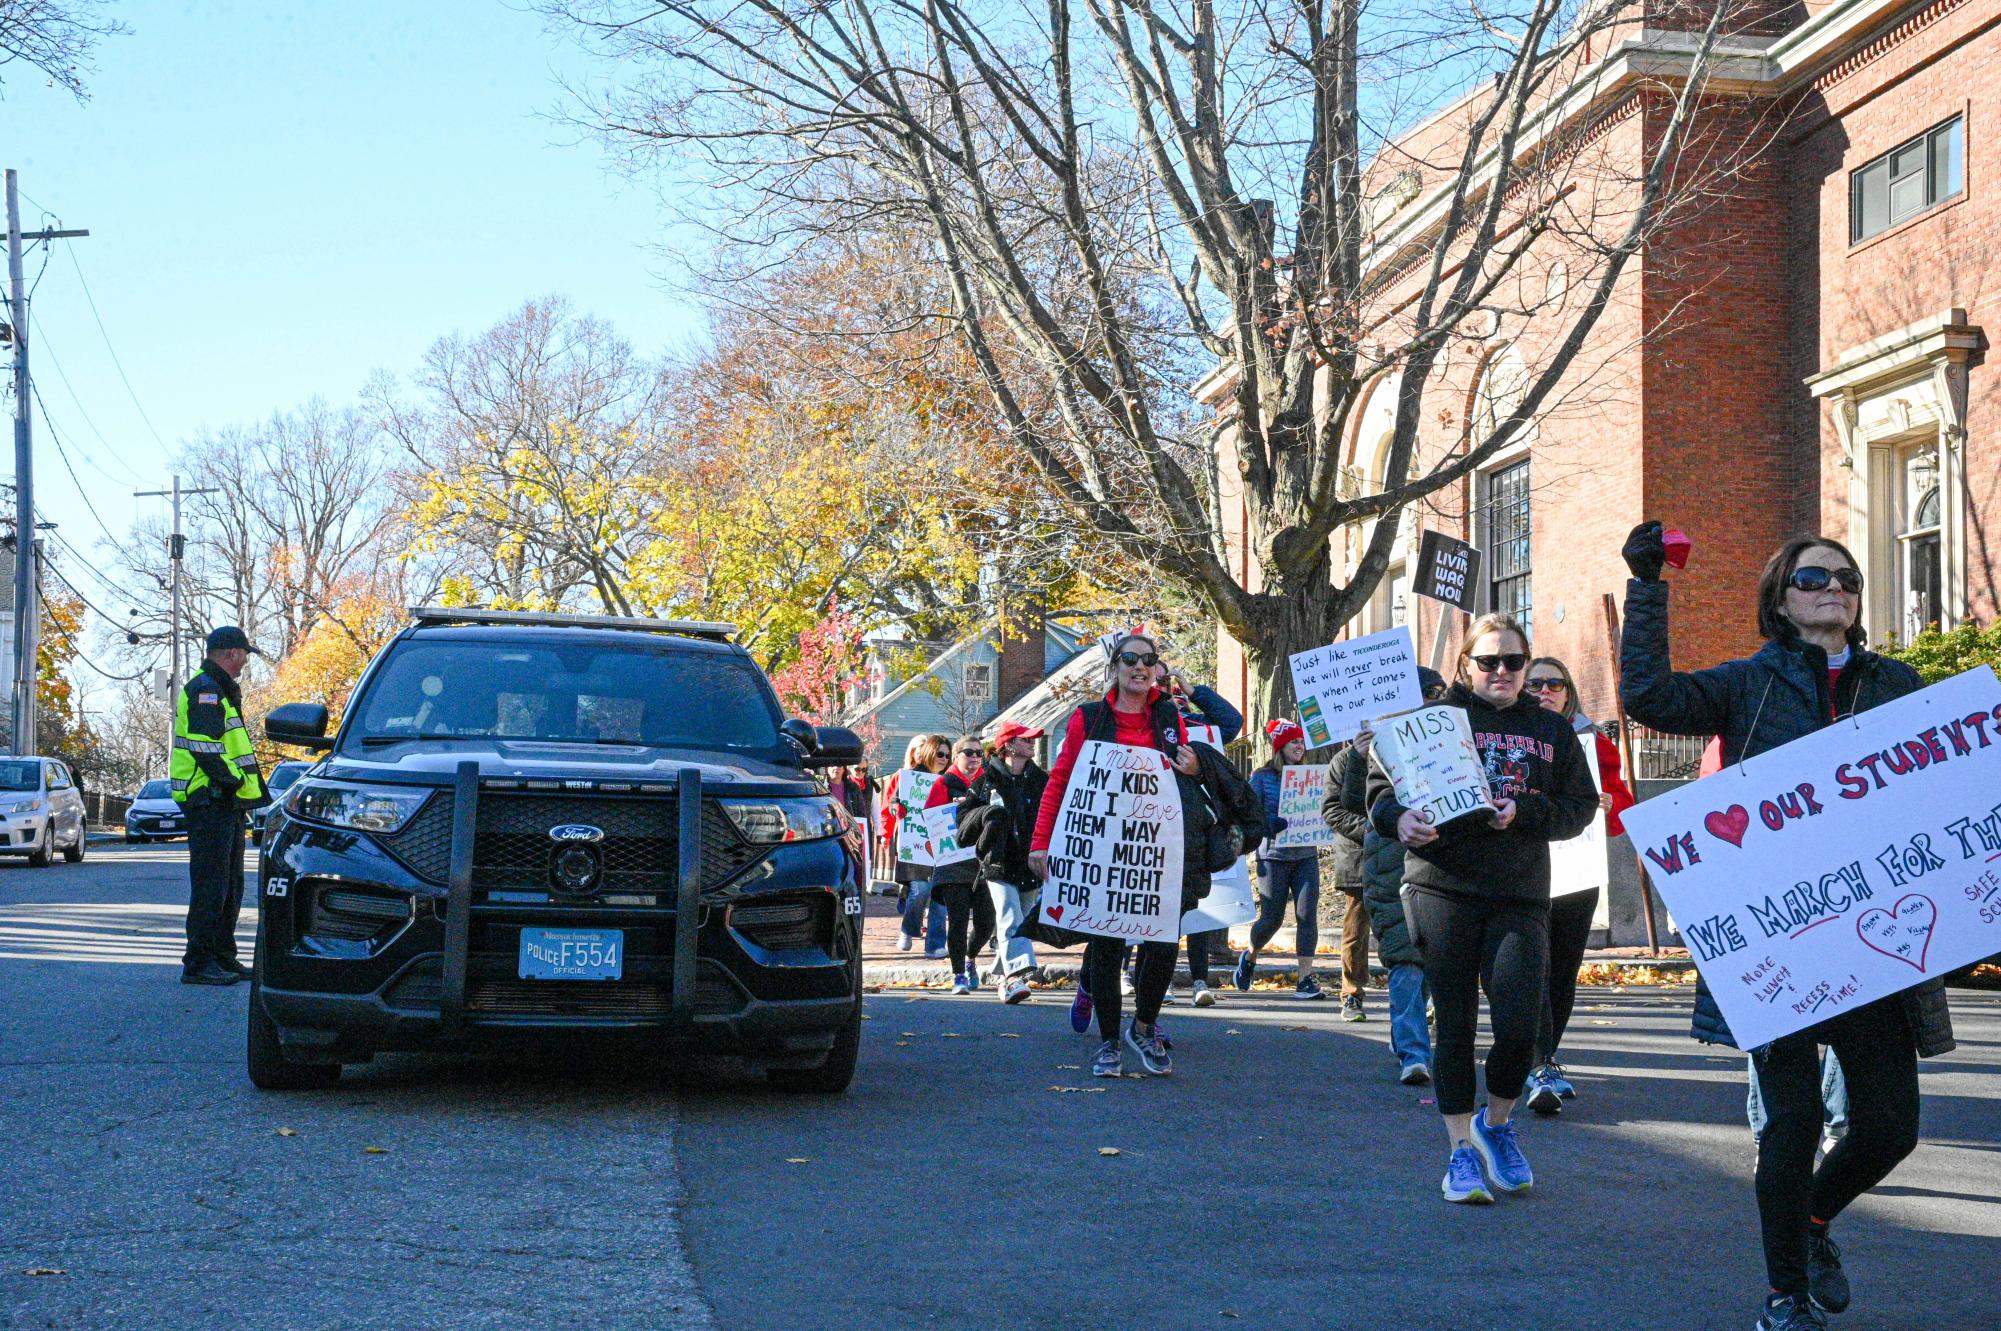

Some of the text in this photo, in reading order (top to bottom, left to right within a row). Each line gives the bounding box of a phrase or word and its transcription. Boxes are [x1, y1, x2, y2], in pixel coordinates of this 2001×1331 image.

[1435, 566, 1465, 589] WAG
[1436, 550, 1468, 575] LIVIN
[1294, 639, 1400, 672] Just like TICONDEROGA
[1302, 651, 1408, 685] we will never break
[1322, 671, 1406, 698] when it comes
[1333, 703, 1343, 713] to
[1348, 698, 1365, 709] our
[1395, 710, 1455, 747] MISS
[1089, 743, 1157, 772] I miss
[1087, 767, 1159, 795] MY KIDS
[1070, 788, 1180, 821] BUT I love
[1421, 785, 1486, 825] STUDE
[562, 827, 591, 840] Ford
[1064, 810, 1161, 843] THEM WAY
[1279, 828, 1335, 844] deserve
[1645, 831, 1702, 876] WE
[1760, 782, 1824, 831] OUR
[1065, 835, 1166, 868] TOO MUCH
[267, 877, 289, 897] 65
[1046, 855, 1164, 892] NOT TO FIGHT
[1686, 803, 2001, 962] WE MARCH FOR TH
[1964, 870, 2000, 901] SAFE
[844, 896, 861, 914] 65
[1058, 882, 1161, 916] FOR THEIR
[1069, 909, 1163, 936] future
[527, 942, 617, 968] POLICE F554
[1741, 955, 1775, 985] MORE
[553, 967, 586, 975] OFFICIAL
[1754, 966, 1791, 1002] LUNCH
[1792, 980, 1830, 1014] RECESS
